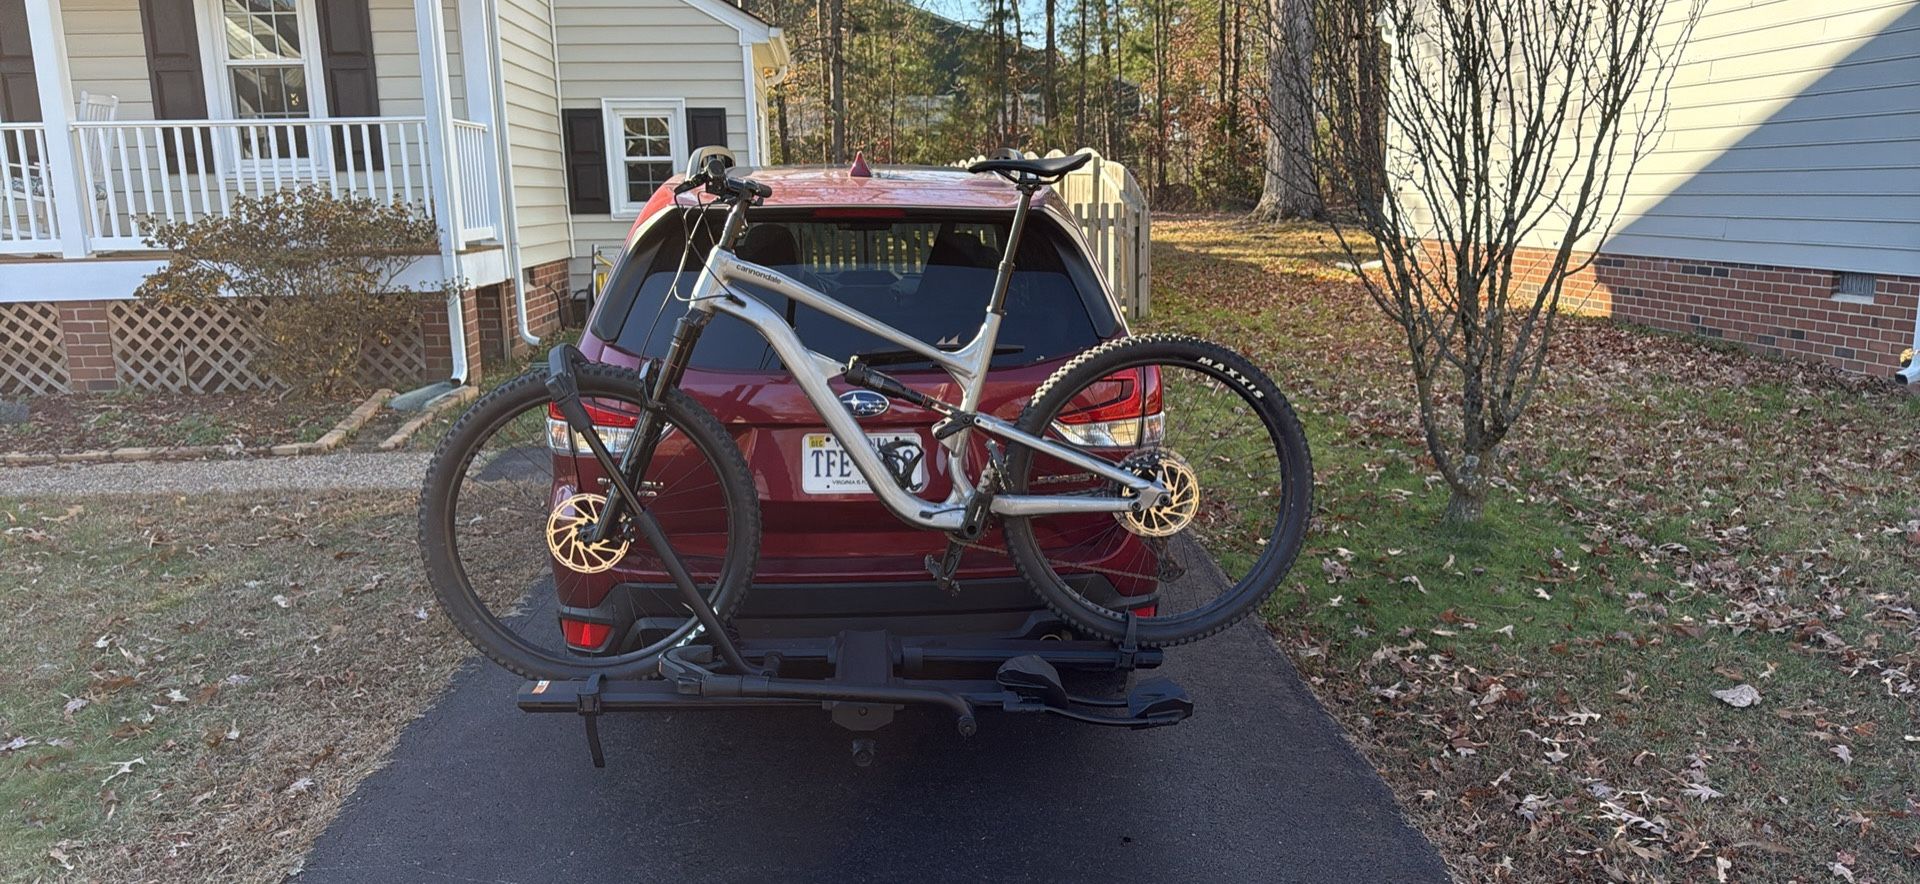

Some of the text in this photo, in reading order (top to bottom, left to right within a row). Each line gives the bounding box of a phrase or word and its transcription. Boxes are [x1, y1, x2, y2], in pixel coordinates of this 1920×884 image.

[736, 264, 782, 284] cannondale
[1197, 357, 1264, 398] MAXXIS
[811, 450, 852, 477] TFE
